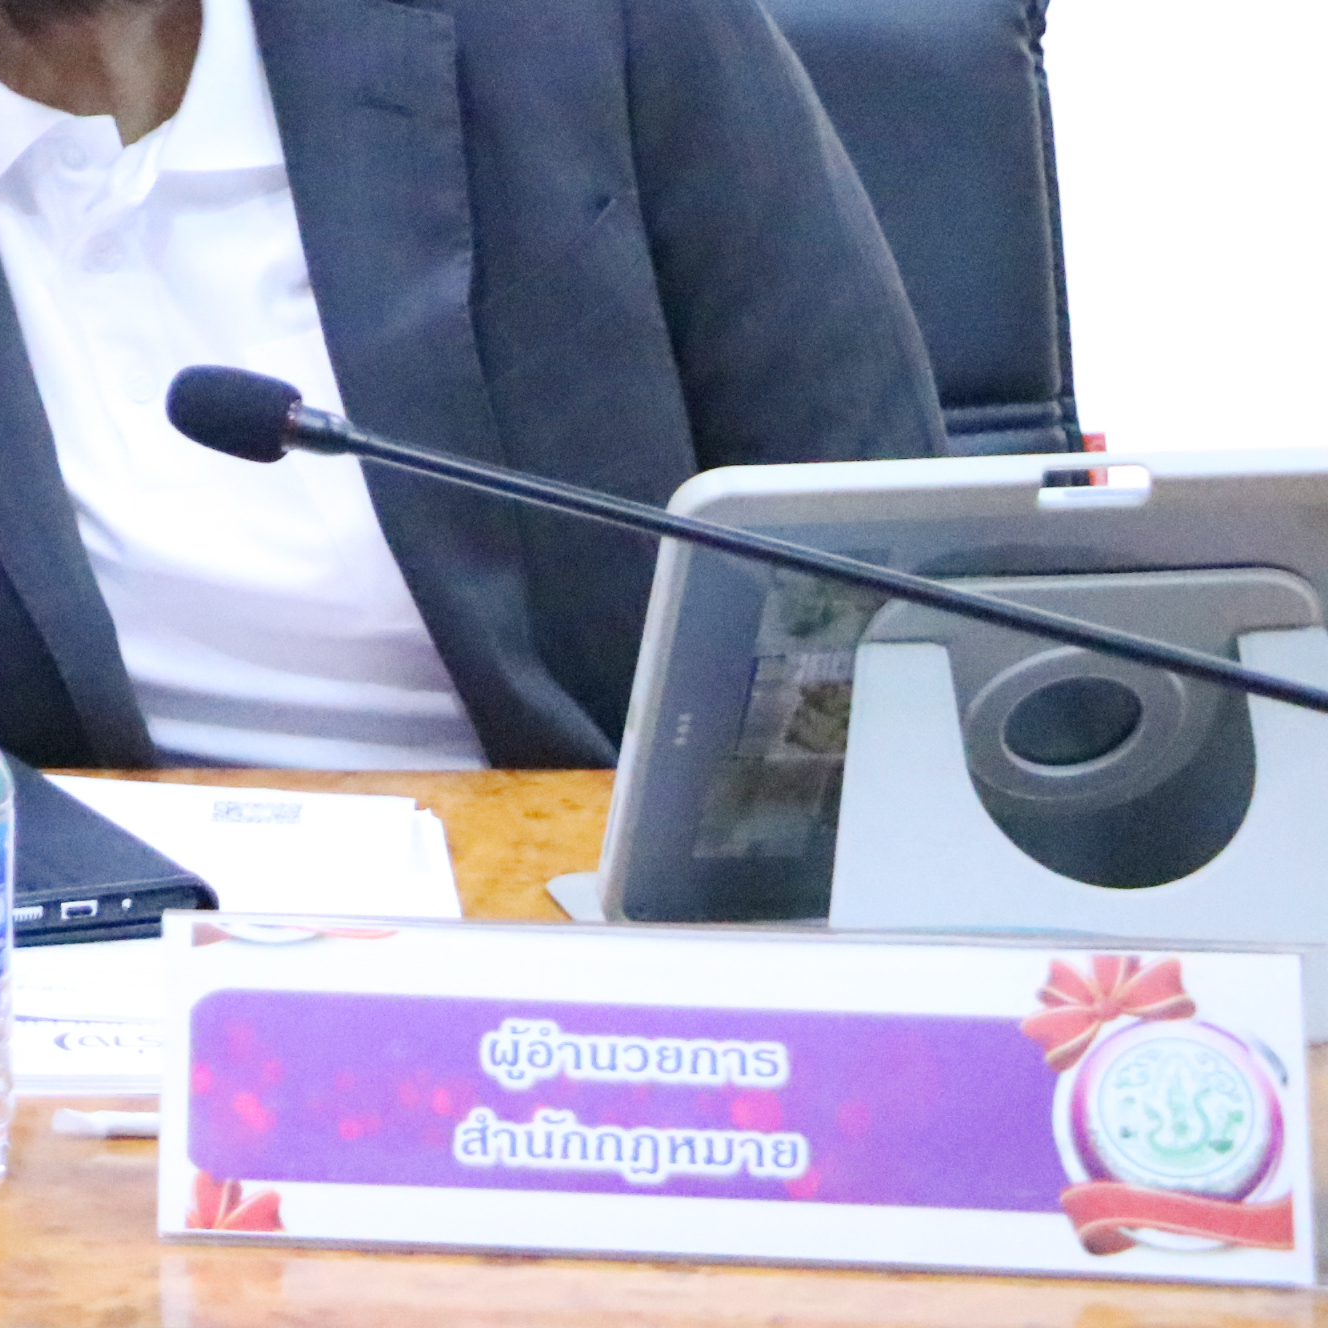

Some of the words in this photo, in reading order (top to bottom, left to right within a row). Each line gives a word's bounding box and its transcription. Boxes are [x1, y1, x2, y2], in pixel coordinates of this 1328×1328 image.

[489, 1025, 780, 1081] ผู้อำนวยการ
[460, 1112, 799, 1175] สำนักกฎหมาย
